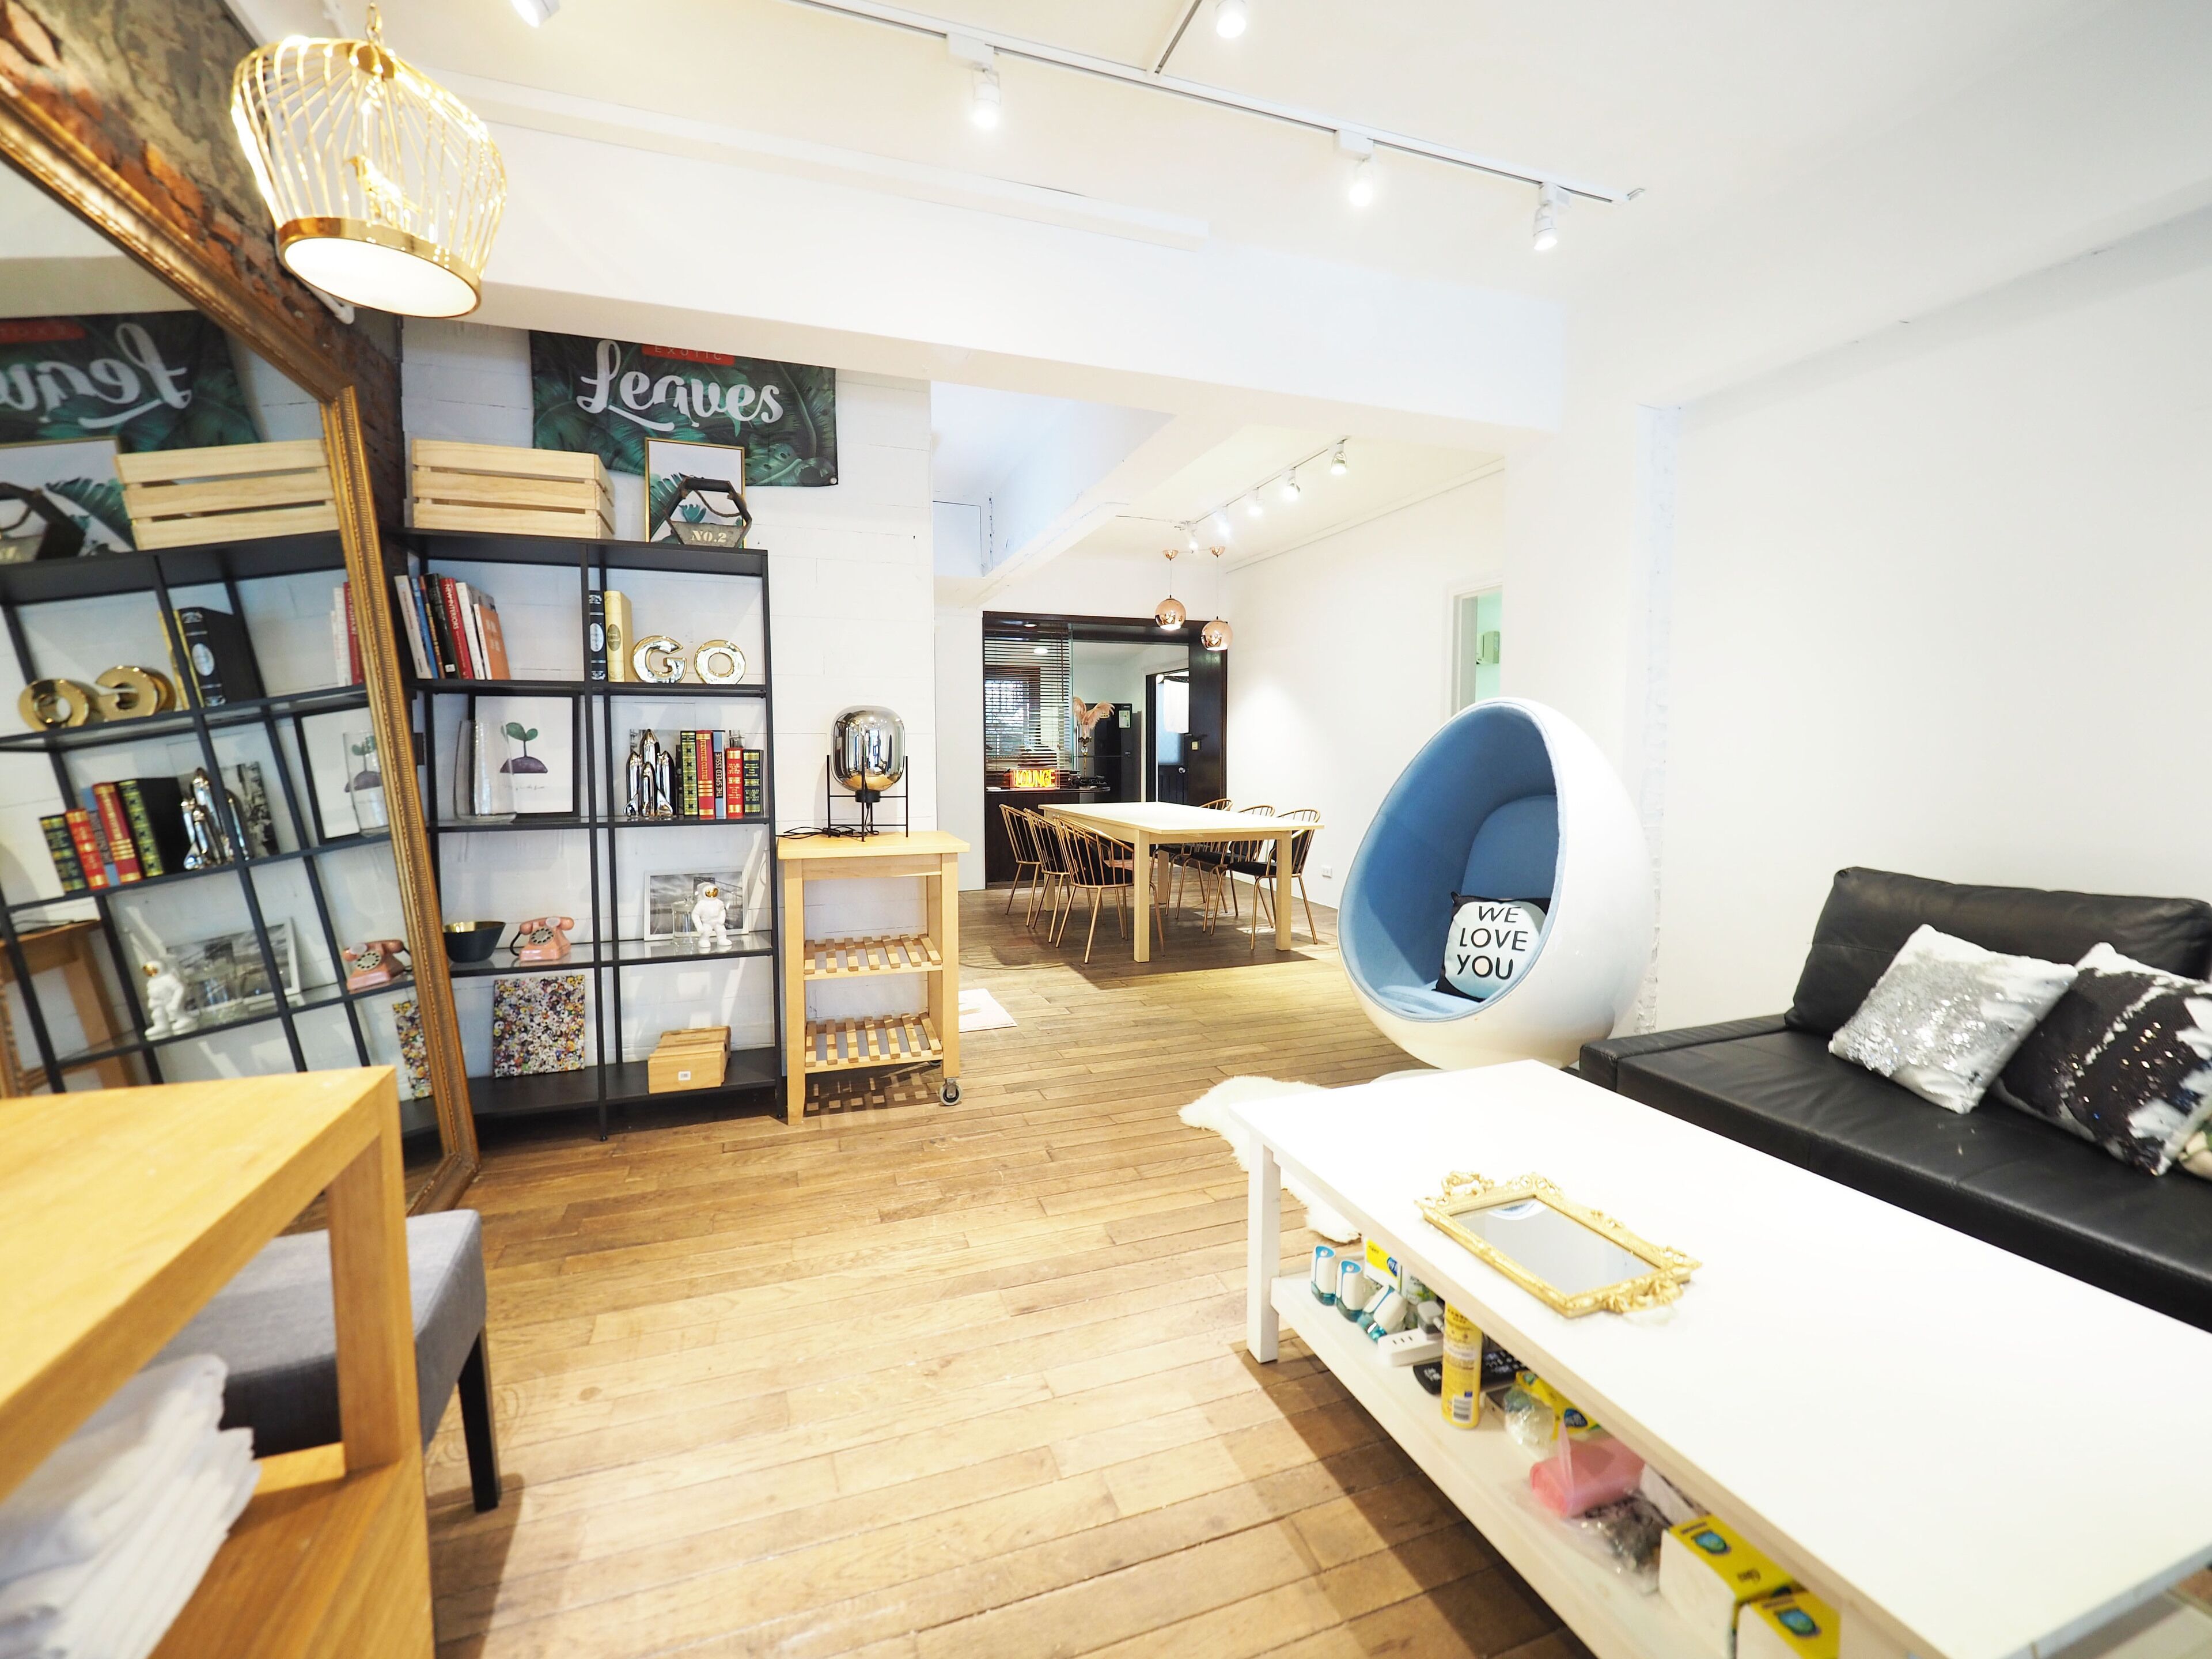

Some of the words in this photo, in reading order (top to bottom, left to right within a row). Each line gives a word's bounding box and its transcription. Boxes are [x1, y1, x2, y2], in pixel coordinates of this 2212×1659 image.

[655, 345, 721, 361] EXOTIC
[576, 339, 784, 432] Leaves
[690, 529, 727, 543] NO.2
[632, 635, 746, 685] GO
[1013, 768, 1056, 787] LOUNGE
[1478, 906, 1521, 923] WE
[1459, 927, 1529, 952] LOVE
[1457, 954, 1514, 980] YOU
